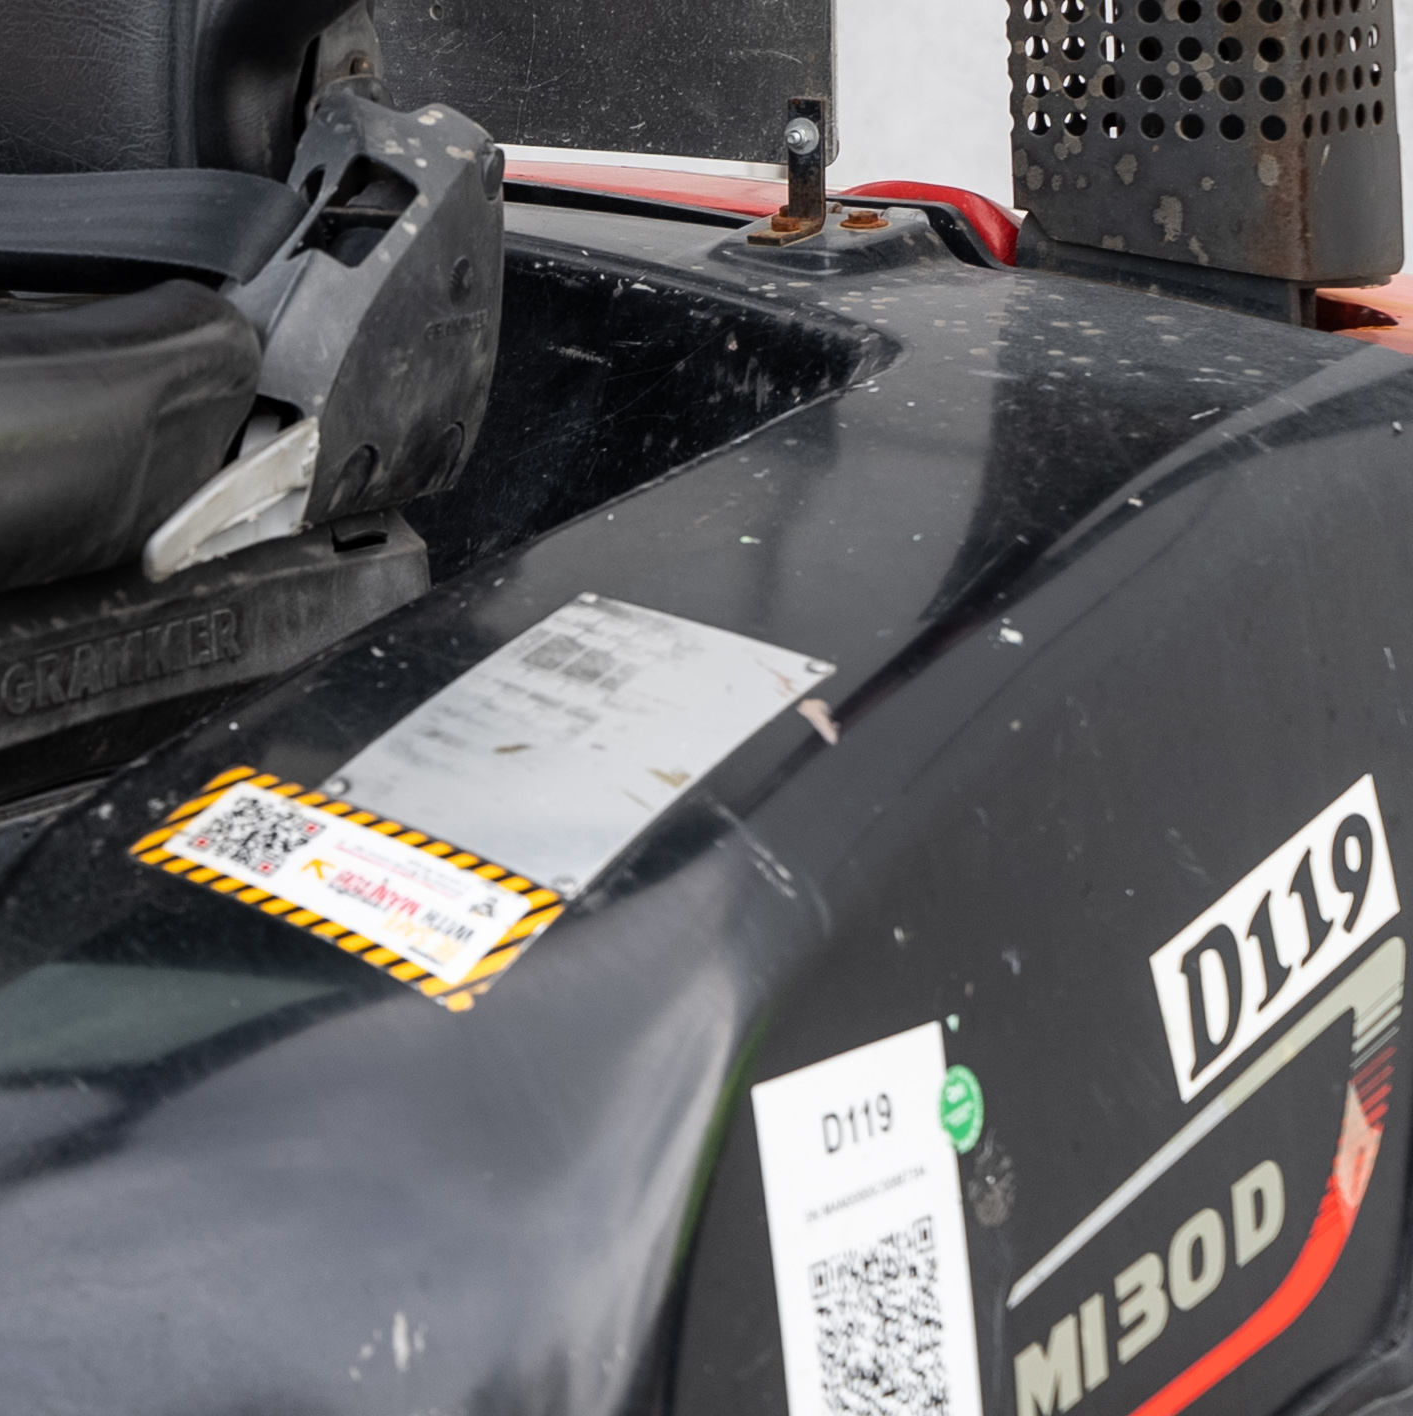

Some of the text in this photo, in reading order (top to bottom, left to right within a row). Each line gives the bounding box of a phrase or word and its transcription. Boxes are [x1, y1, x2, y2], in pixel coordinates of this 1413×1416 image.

[1, 607, 243, 716] GRAMMER
[1179, 813, 1373, 1082] D119
[822, 1092, 892, 1155] D119
